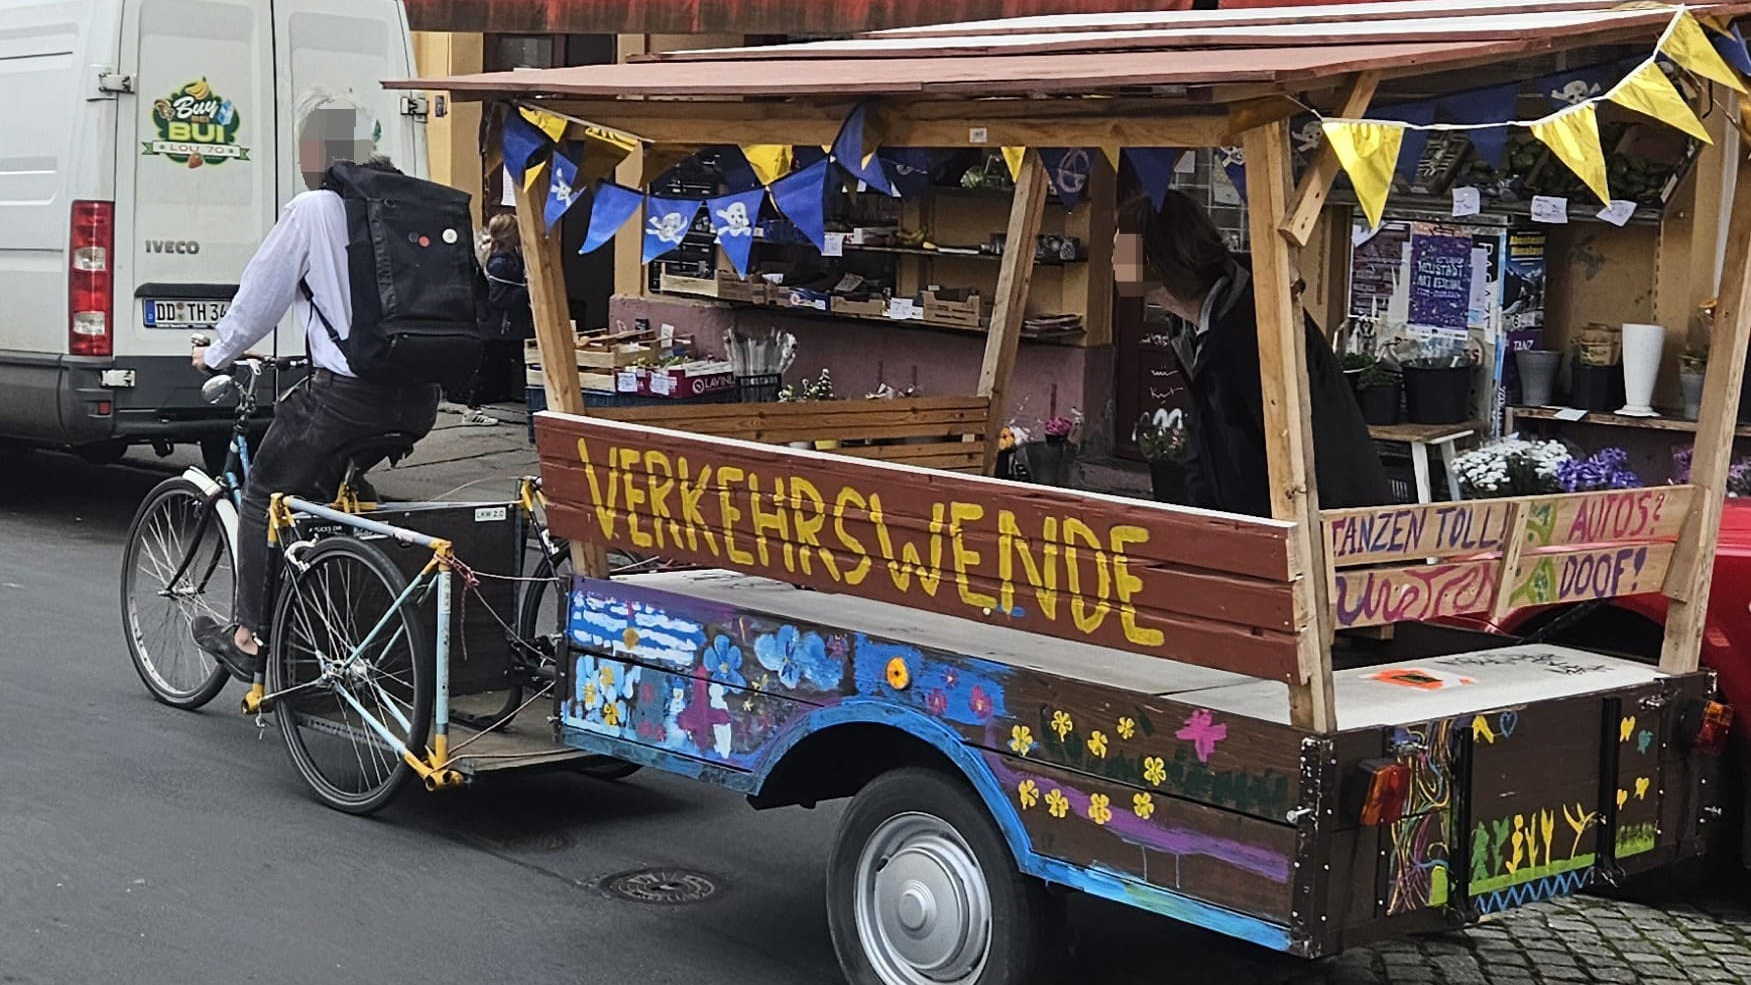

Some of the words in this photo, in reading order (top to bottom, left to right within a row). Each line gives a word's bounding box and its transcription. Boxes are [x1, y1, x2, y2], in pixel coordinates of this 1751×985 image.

[173, 96, 218, 119] Buy
[168, 121, 224, 143] BUI
[145, 240, 200, 255] IVECO
[156, 303, 176, 321] DD
[187, 303, 206, 321] TH
[1331, 508, 1427, 557] TANZEN
[1436, 502, 1512, 551] TOLL!
[1567, 490, 1665, 542] AUTOS?
[577, 437, 1165, 647] VERKEHRSWENDE
[1559, 547, 1648, 599] DOOF!
